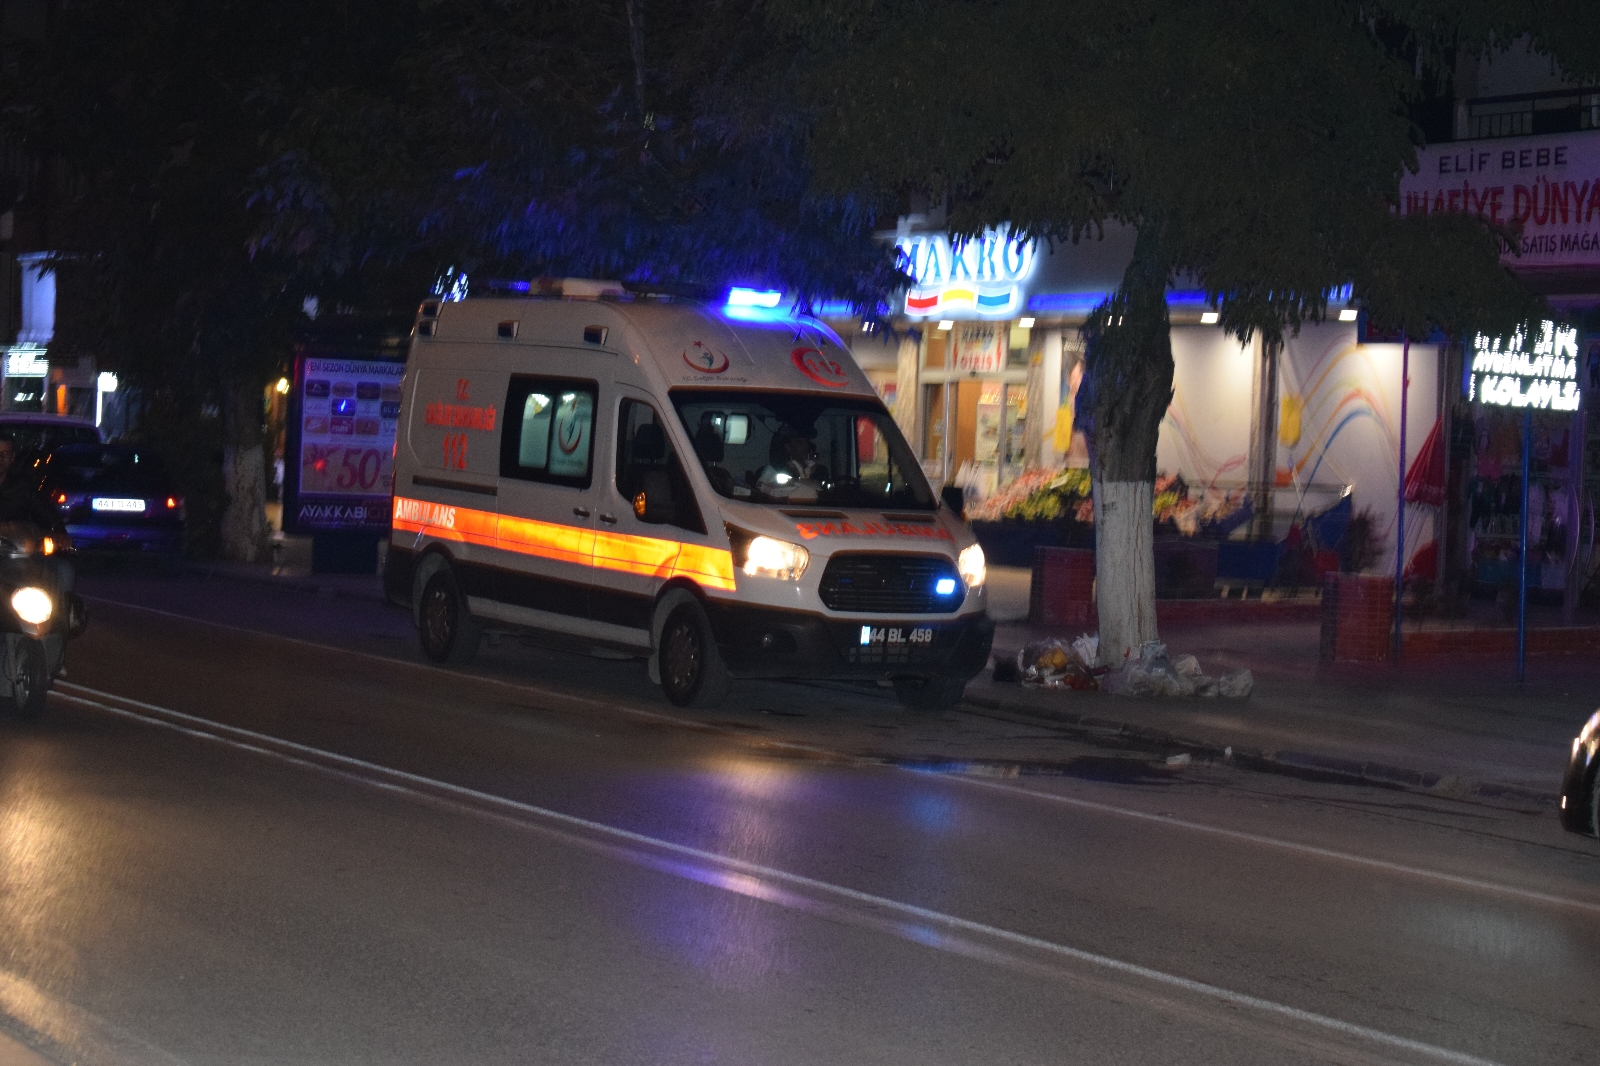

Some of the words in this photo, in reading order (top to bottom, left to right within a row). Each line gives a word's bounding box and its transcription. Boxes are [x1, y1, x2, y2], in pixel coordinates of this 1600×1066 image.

[1439, 148, 1491, 174] ELİF
[1501, 146, 1568, 169] BEBE
[895, 233, 1032, 284] MAKRO
[806, 358, 846, 377] 112
[443, 432, 468, 469] 112
[395, 498, 455, 529] AMBULANS
[870, 628, 886, 642] 44
[887, 628, 907, 642] BL
[908, 628, 932, 642] 458
